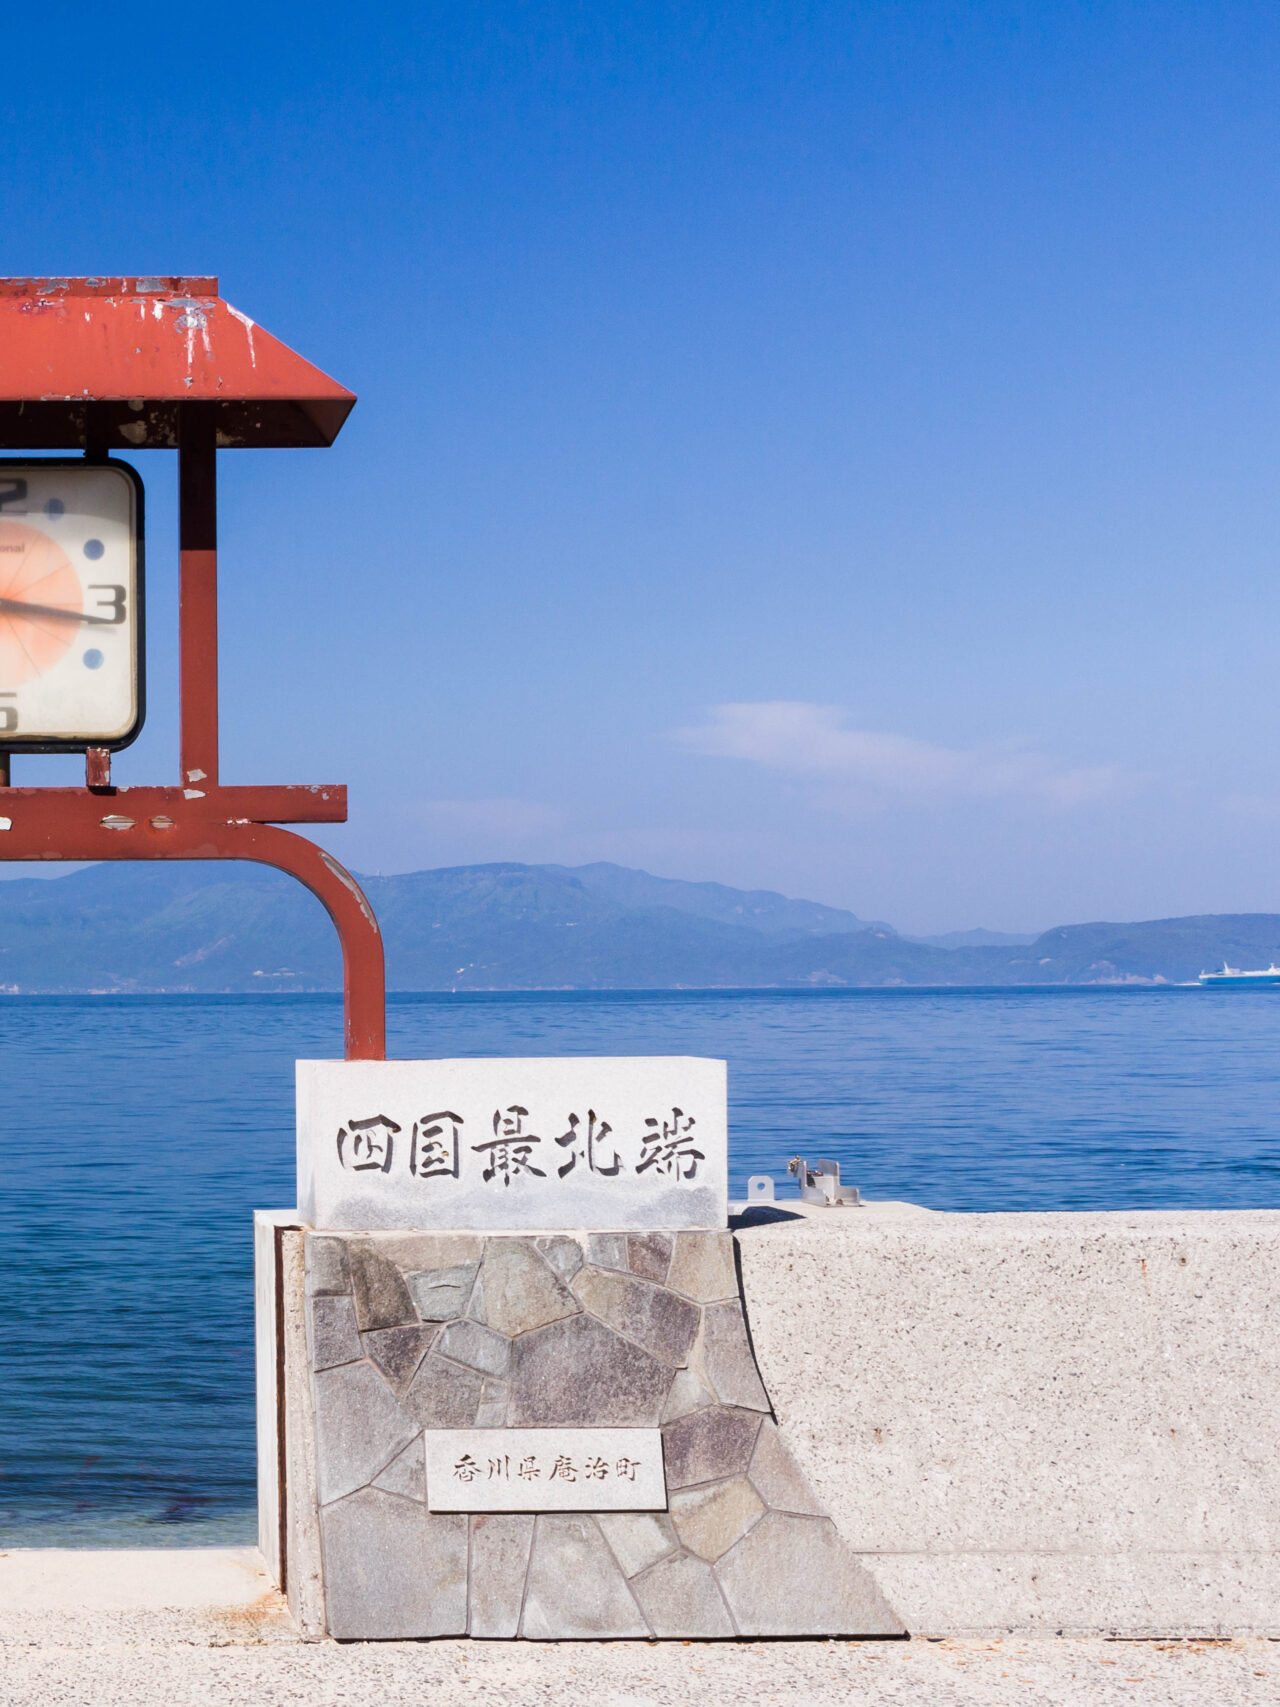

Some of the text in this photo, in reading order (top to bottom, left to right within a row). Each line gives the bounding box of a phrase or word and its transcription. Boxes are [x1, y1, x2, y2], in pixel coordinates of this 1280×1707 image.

[87, 584, 127, 625] 3
[336, 1104, 706, 1187] 四国最北端
[453, 1454, 643, 1482] 香川県庵治町
